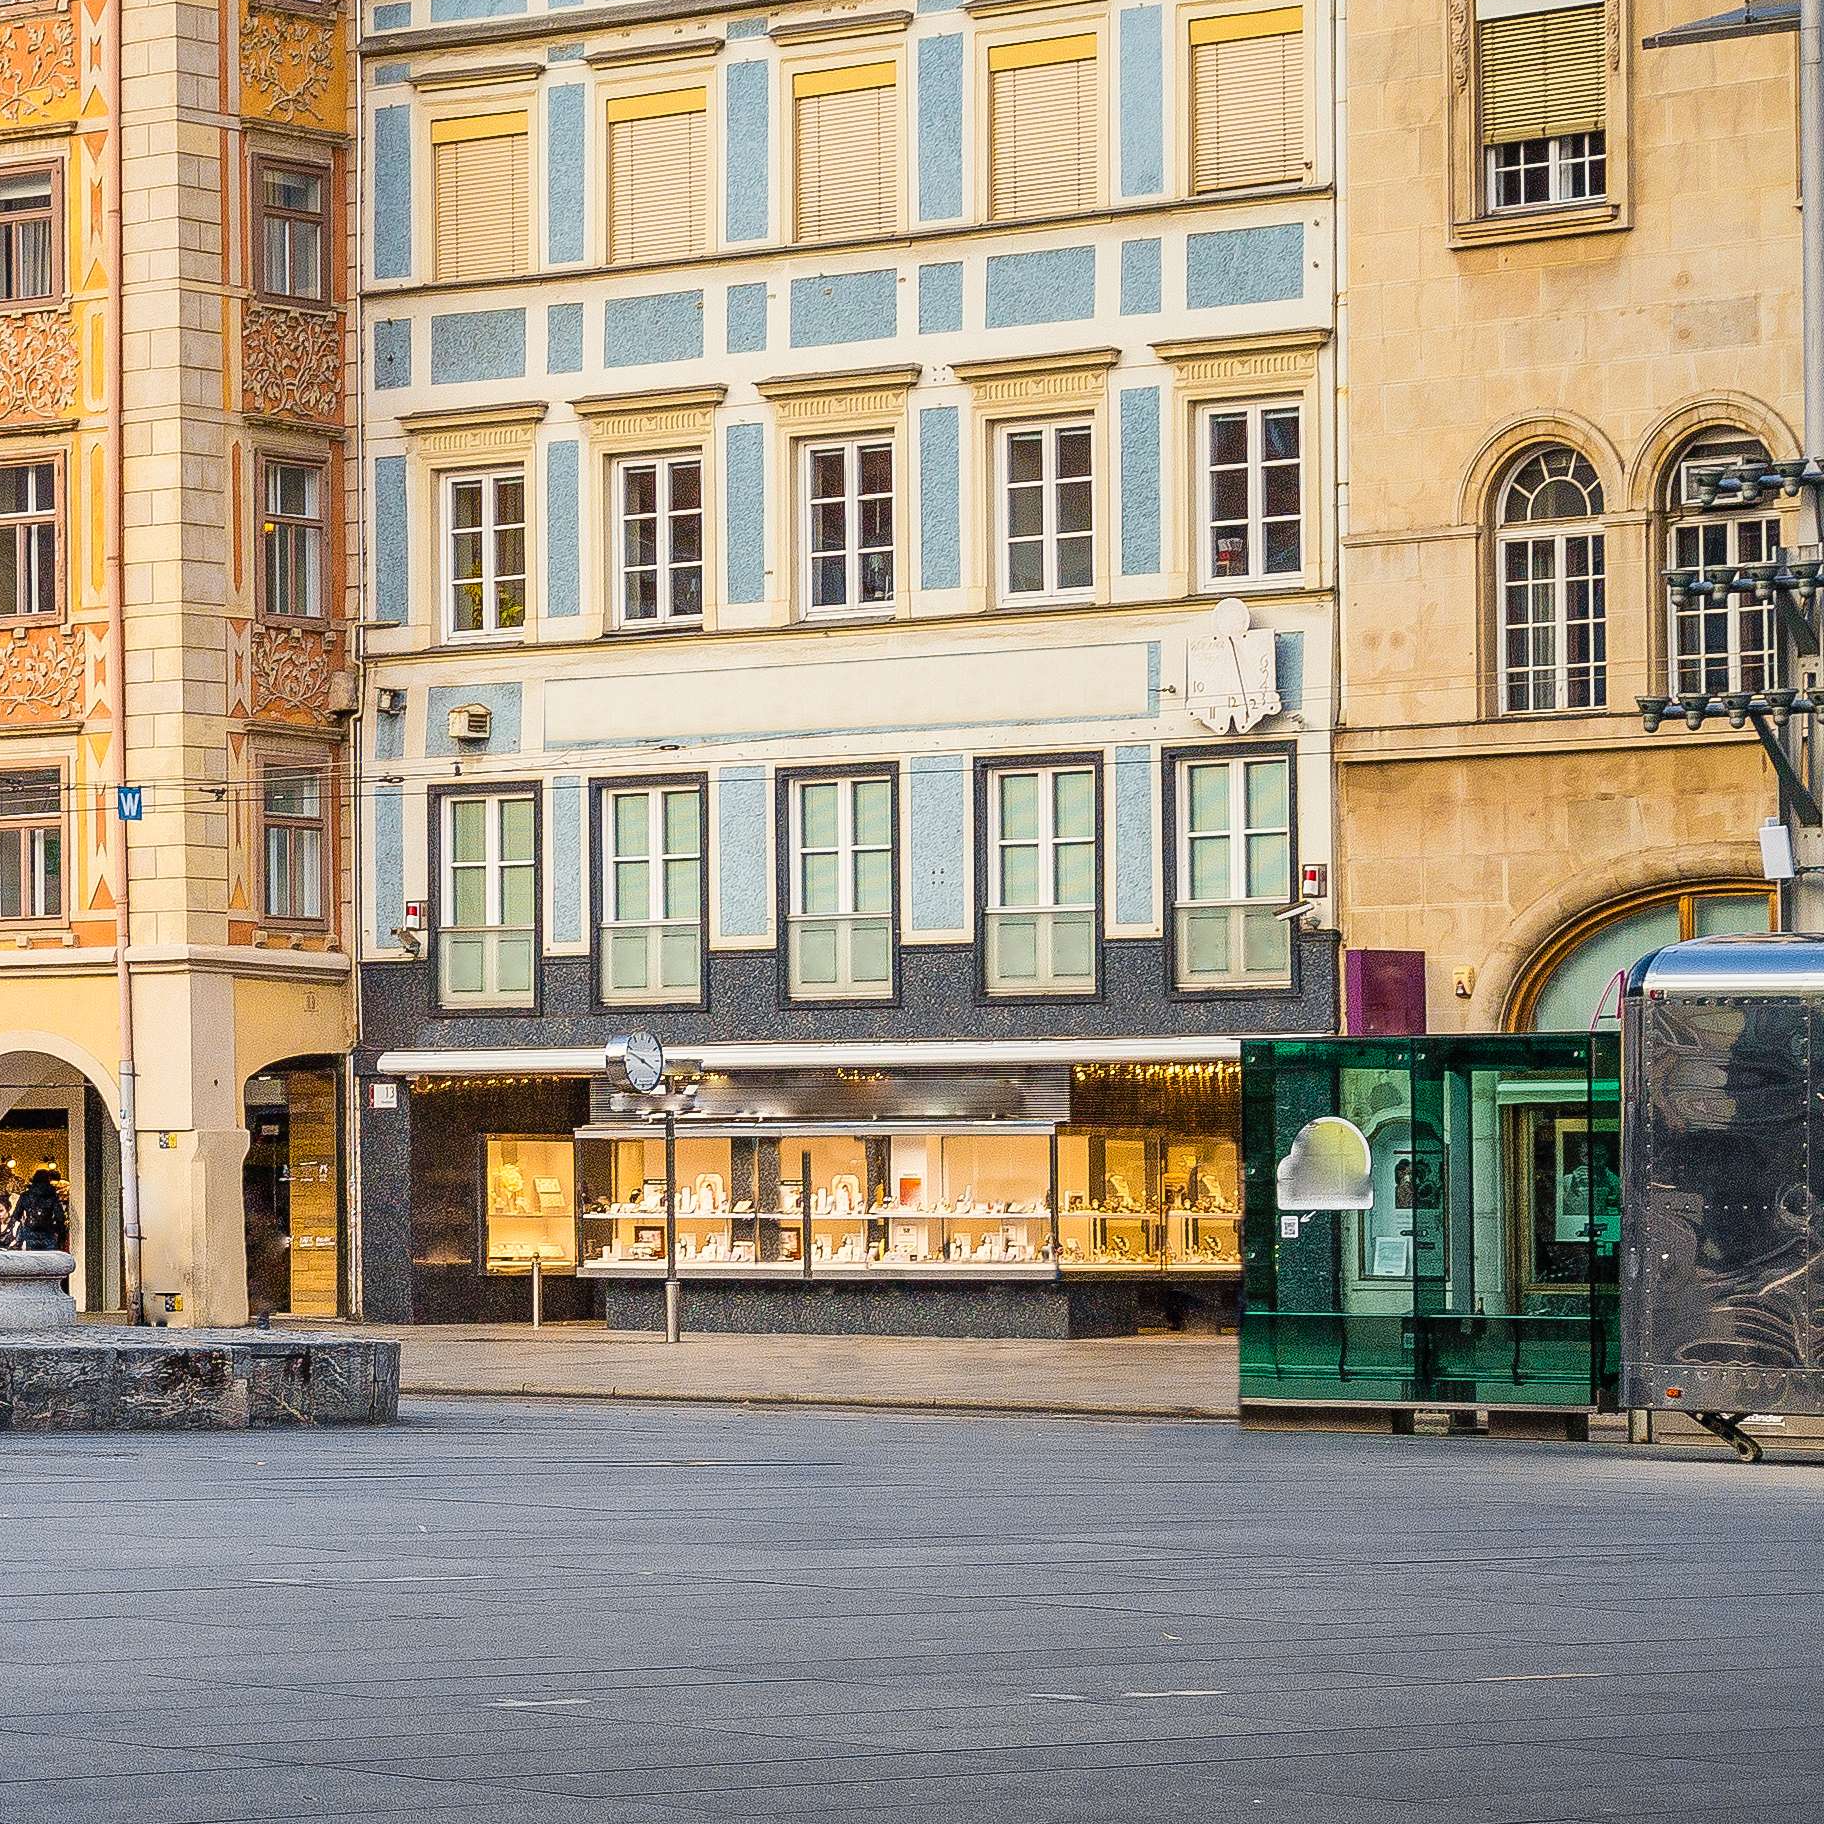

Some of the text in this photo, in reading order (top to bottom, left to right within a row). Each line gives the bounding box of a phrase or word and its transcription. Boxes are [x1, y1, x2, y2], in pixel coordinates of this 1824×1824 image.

[1193, 680, 1206, 694] 10
[120, 792, 140, 817] W
[385, 1085, 395, 1099] 13
